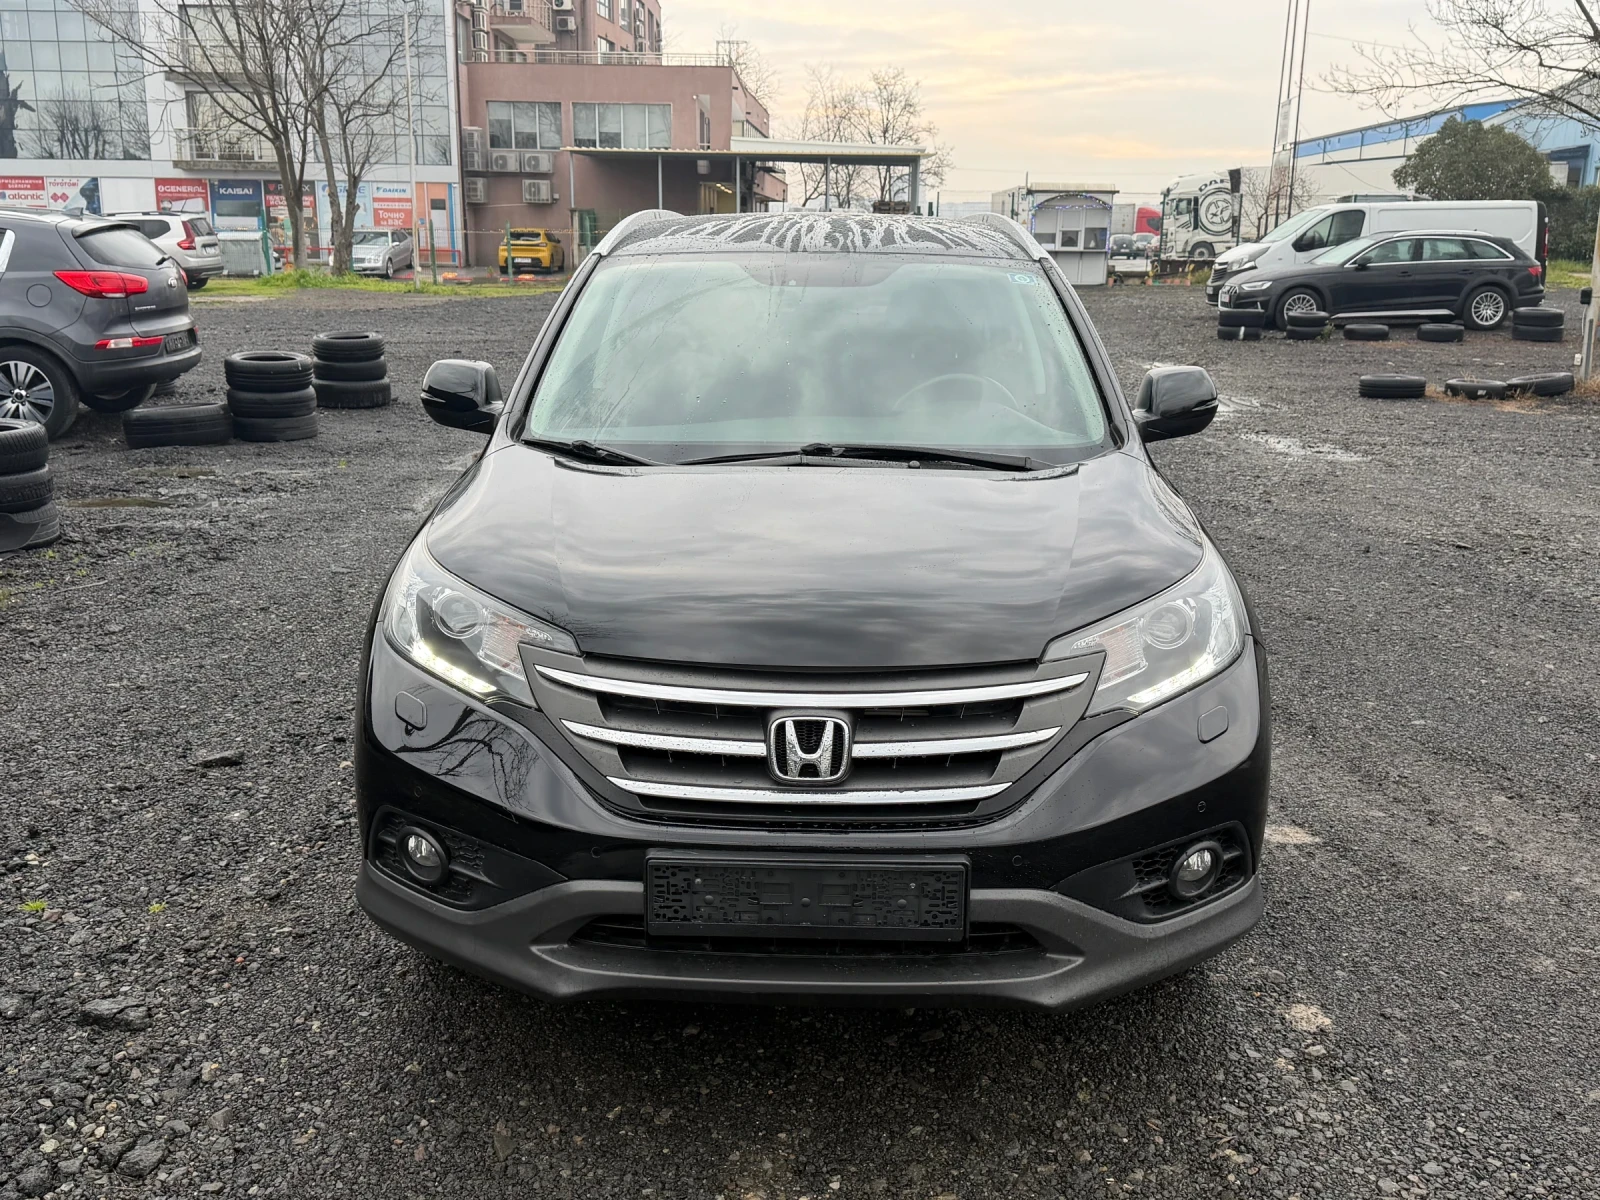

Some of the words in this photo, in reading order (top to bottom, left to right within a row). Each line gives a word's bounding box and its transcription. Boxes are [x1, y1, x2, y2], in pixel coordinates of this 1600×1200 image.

[219, 187, 253, 195] KAISAI
[8, 191, 44, 201] atlantic
[377, 210, 405, 219] Точно
[388, 218, 403, 226] вас
